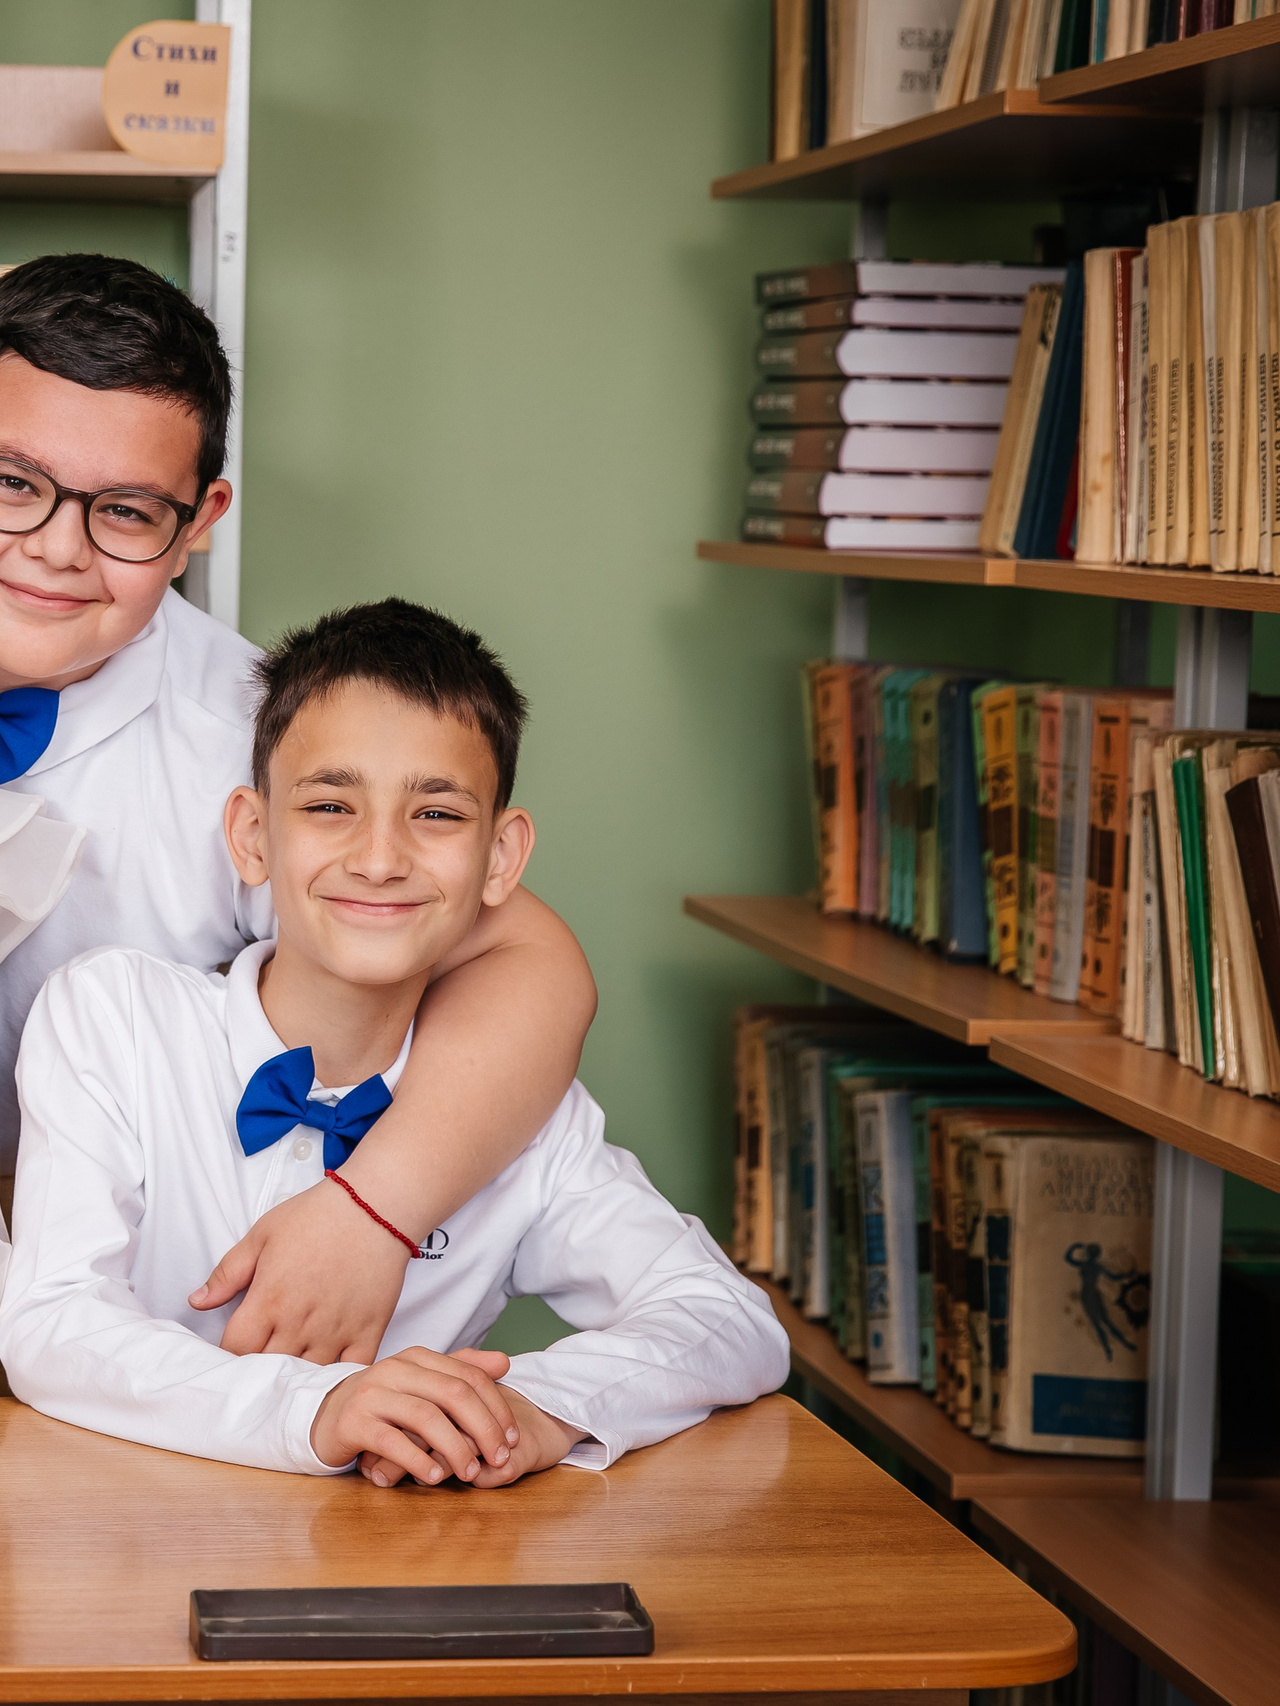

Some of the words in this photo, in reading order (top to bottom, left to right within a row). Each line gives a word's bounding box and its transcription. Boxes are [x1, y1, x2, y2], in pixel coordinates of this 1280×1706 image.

[131, 35, 218, 63] Стихи
[165, 80, 180, 97] и
[418, 1250, 444, 1260] Dior
